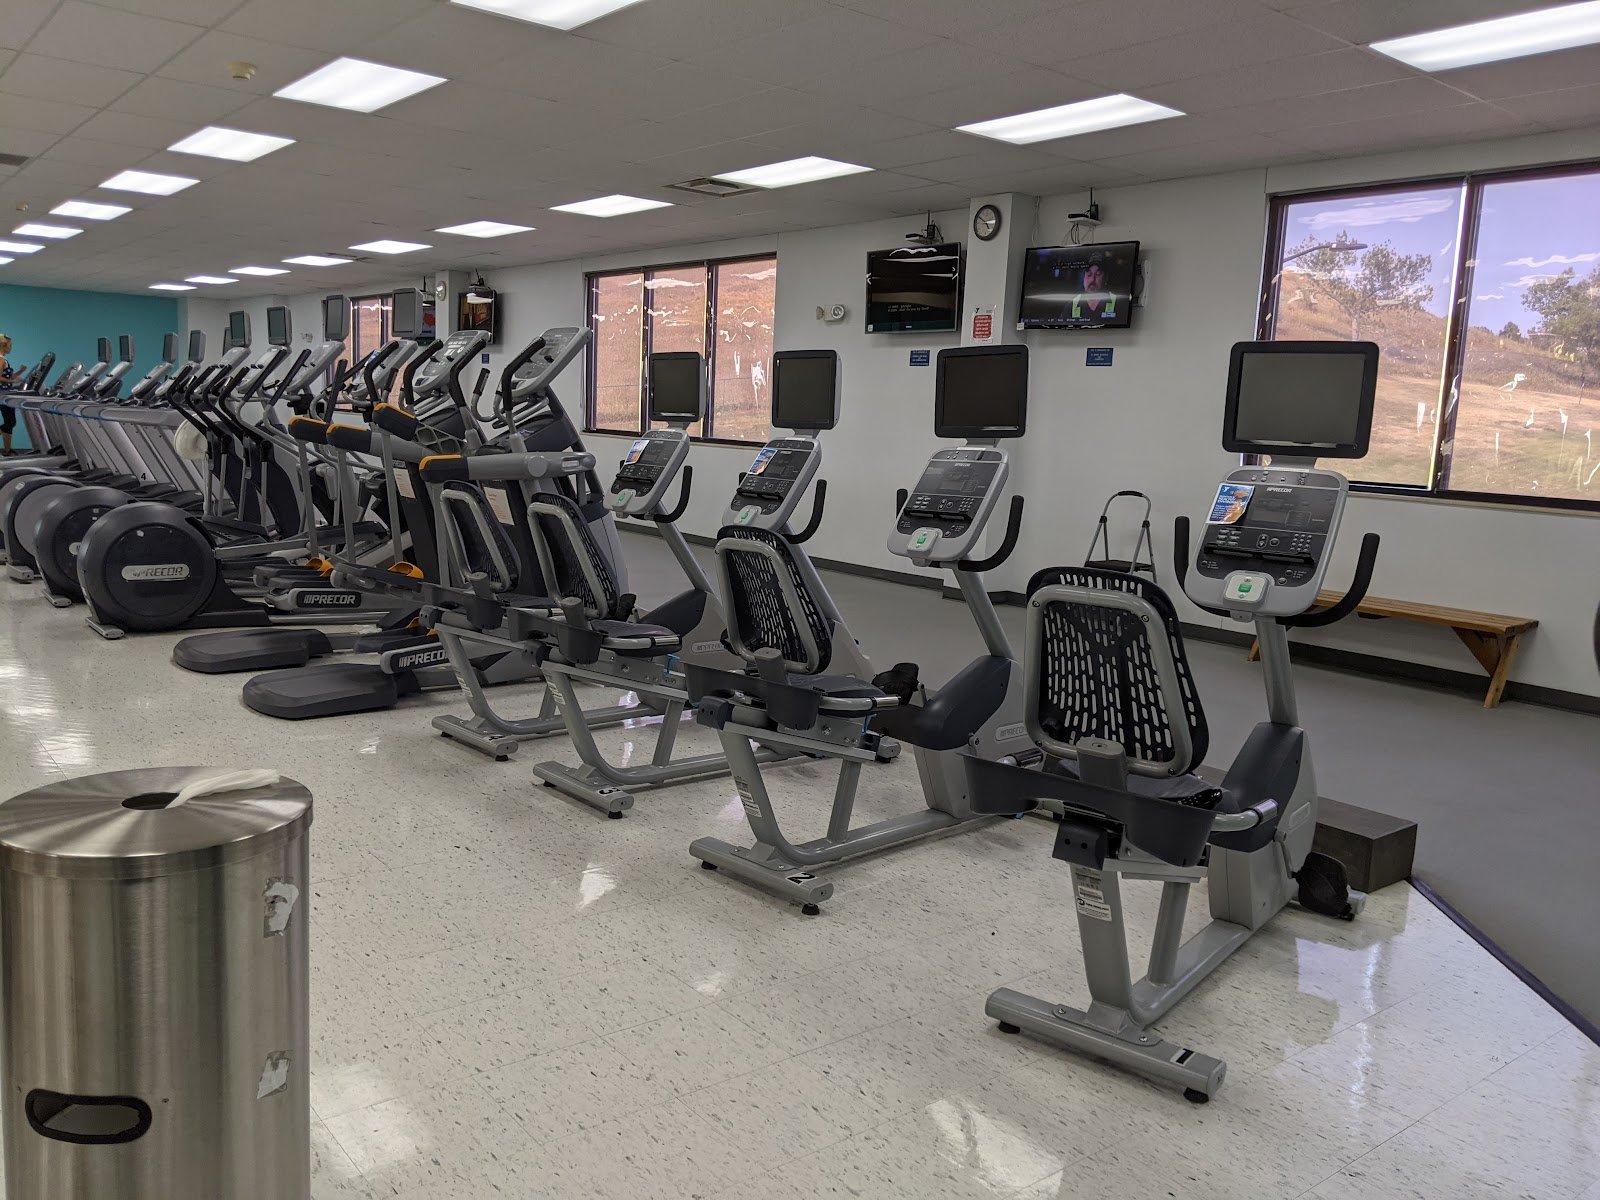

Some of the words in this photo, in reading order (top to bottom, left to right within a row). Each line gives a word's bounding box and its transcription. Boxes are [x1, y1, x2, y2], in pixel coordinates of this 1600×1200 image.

[140, 472, 147, 480] 4
[310, 594, 356, 605] PRECOR
[406, 650, 449, 667] PRECO
[786, 872, 816, 885] 2
[1175, 1047, 1195, 1065] 1
